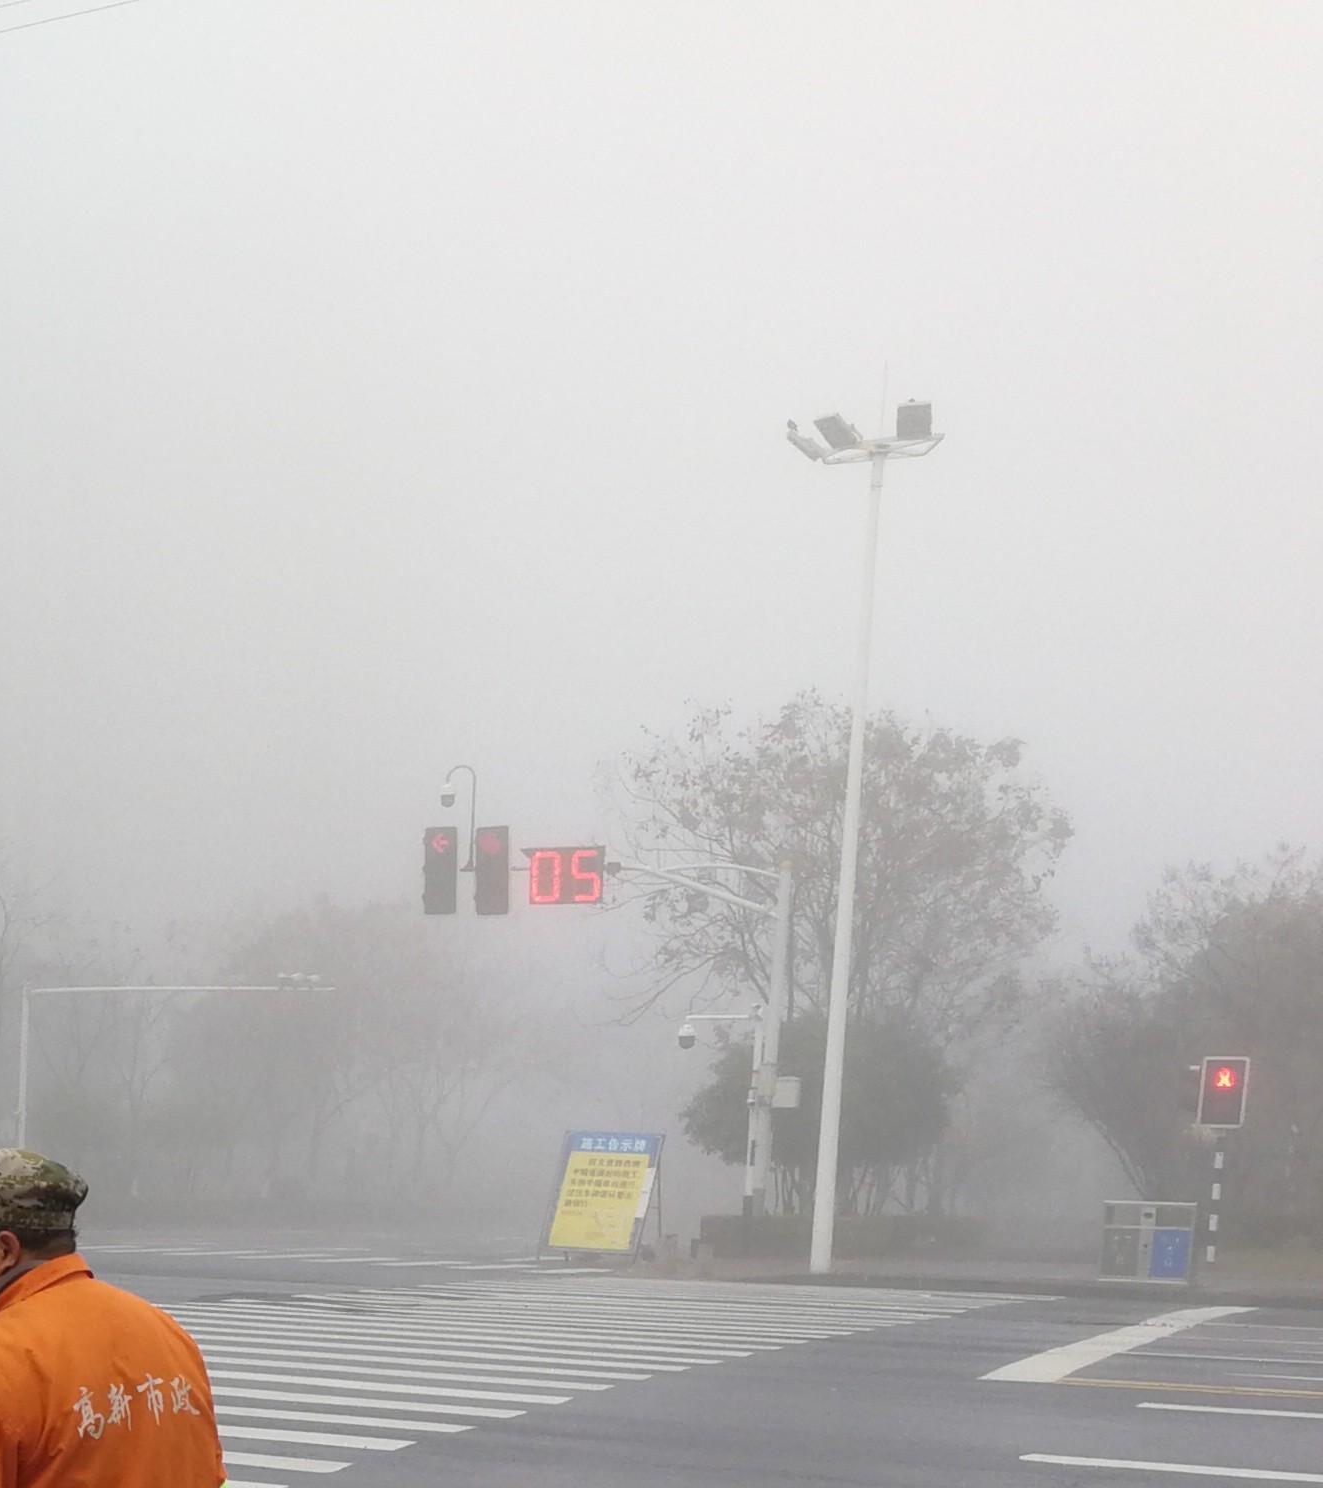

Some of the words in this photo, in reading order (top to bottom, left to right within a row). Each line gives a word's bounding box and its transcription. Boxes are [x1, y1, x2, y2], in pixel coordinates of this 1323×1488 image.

[531, 849, 602, 903] 05
[72, 1372, 201, 1440] 高新市政
